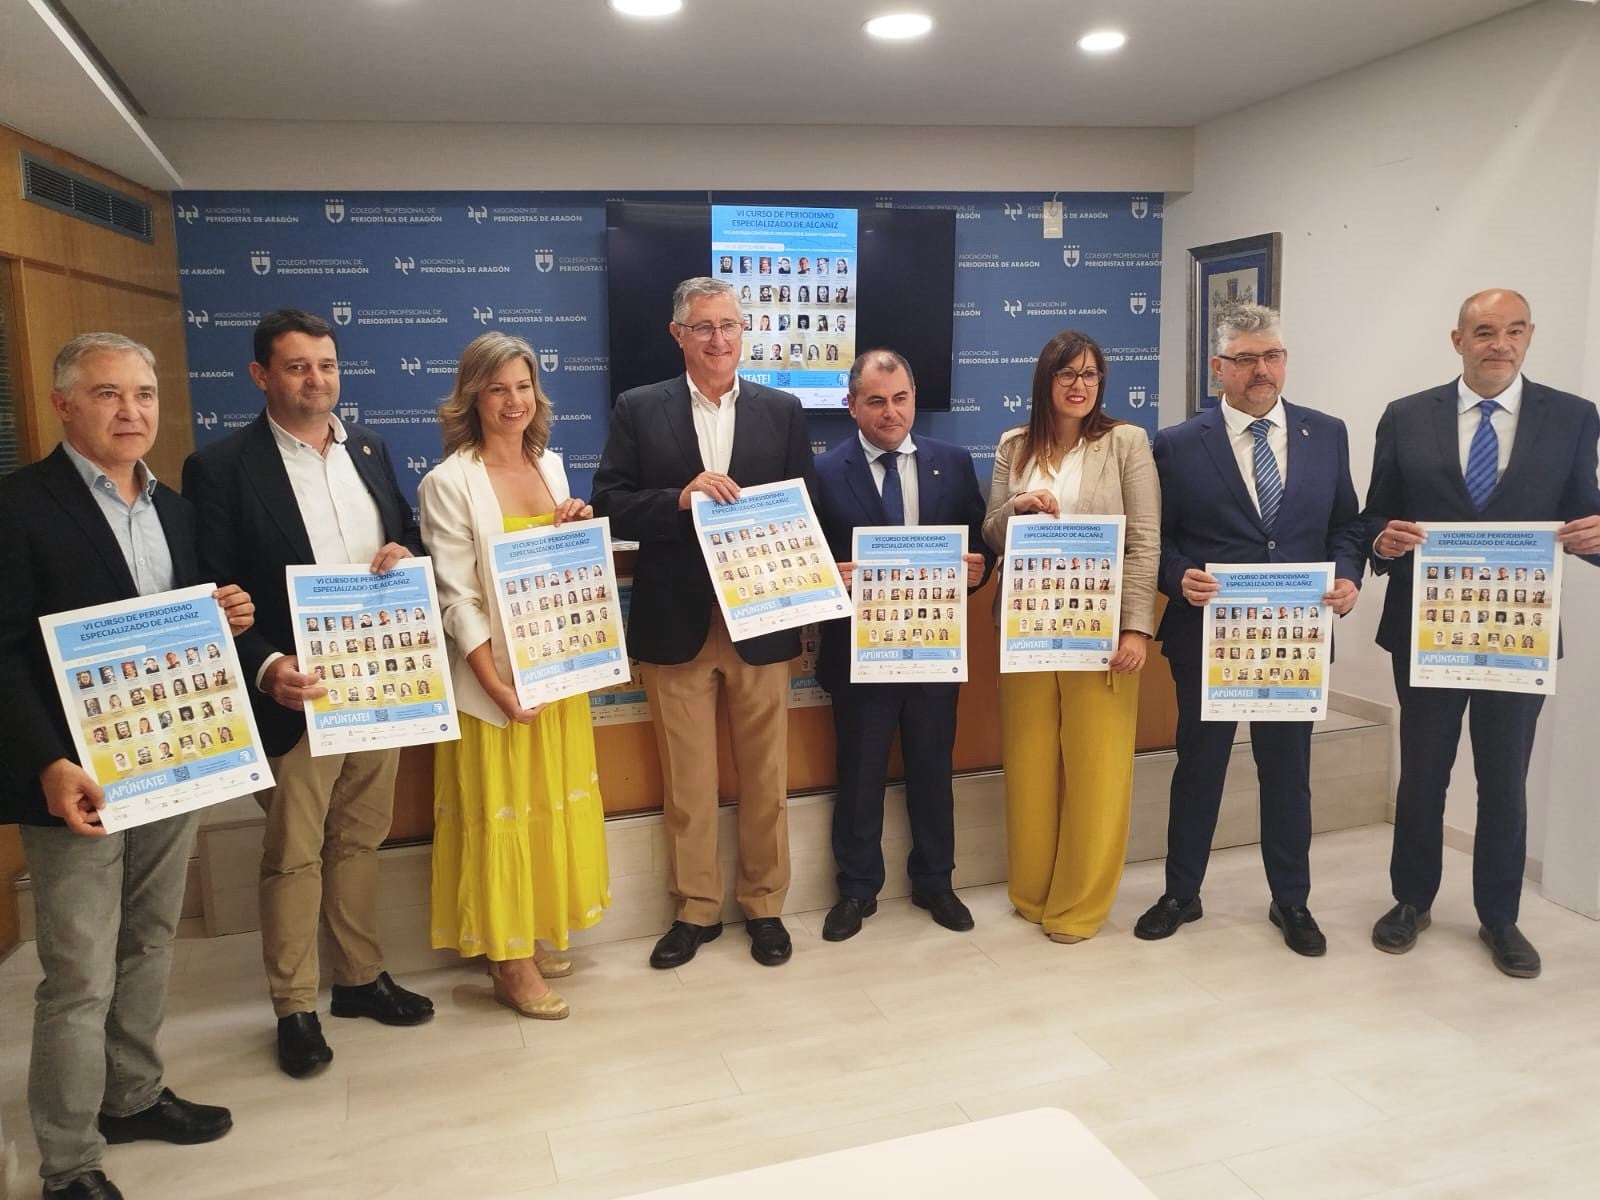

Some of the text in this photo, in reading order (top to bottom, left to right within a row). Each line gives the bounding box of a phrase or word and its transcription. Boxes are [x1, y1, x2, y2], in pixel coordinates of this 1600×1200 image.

[736, 209, 835, 219] VI CURSO DE PERIODISMO
[1079, 211, 1108, 219] ARAGÓN
[265, 215, 299, 223] ARAGÓN
[732, 219, 792, 228] ESPECIALIZADO
[805, 220, 839, 229] ALCAÑIZ
[191, 267, 225, 275] ARAGÓN
[336, 266, 369, 274] ARAGÓN
[1078, 307, 1107, 315] ARAGÓN
[415, 316, 448, 324] ARAGÓN
[555, 314, 587, 322] ARAGÓN
[560, 413, 592, 421] ARAGÓN
[315, 571, 405, 585] VI CURSO DE PERIODISMO
[313, 584, 368, 593] ESPECIALIZADO
[378, 578, 410, 589] ALCAÑIZ
[1285, 579, 1313, 587] ALCAÑIZ
[82, 603, 193, 632] VI CURSO DE PERIODISMO
[79, 621, 150, 642] ESPECIALIZADO
[150, 617, 163, 629] DE
[163, 610, 200, 626] ALCAÑIZ
[107, 774, 168, 801] ¡APÚNTATE!
